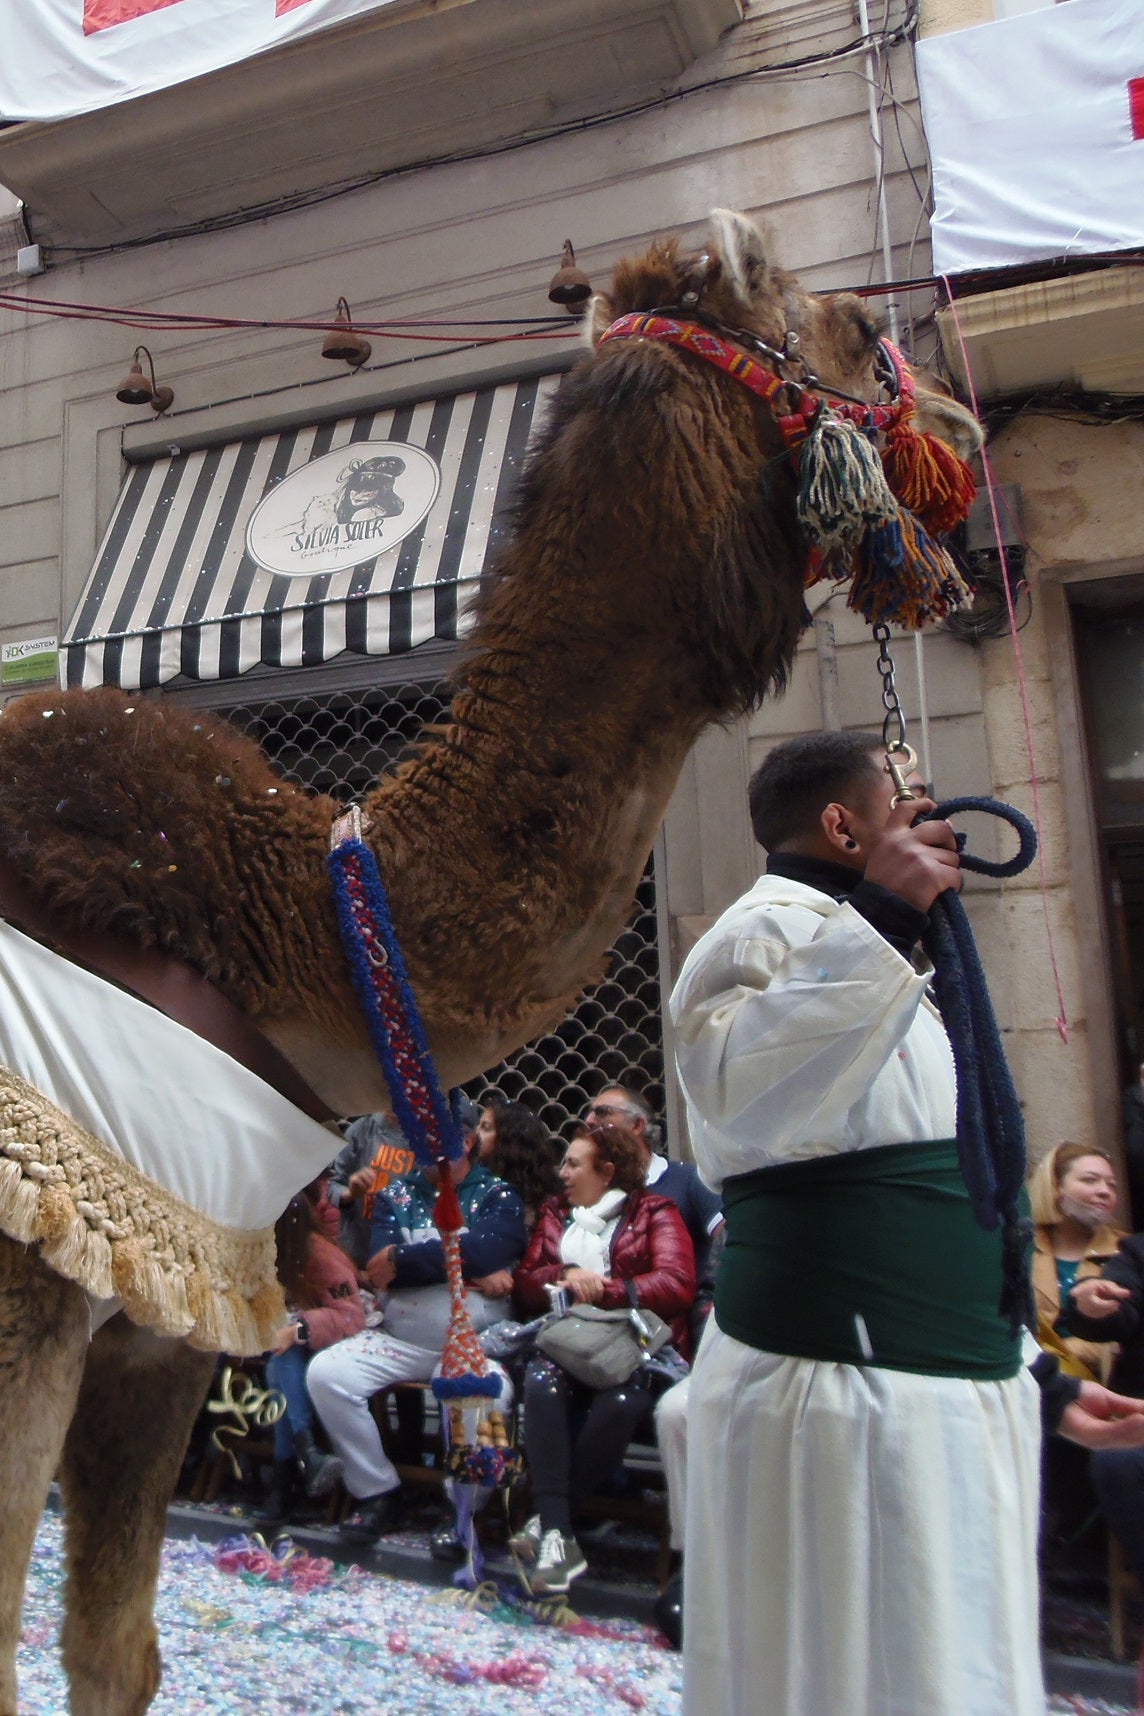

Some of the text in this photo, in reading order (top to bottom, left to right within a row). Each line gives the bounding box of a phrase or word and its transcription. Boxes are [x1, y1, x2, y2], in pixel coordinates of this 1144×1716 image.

[290, 518, 385, 552] SILVIA SOLER
[370, 1144, 415, 1176] JUST
